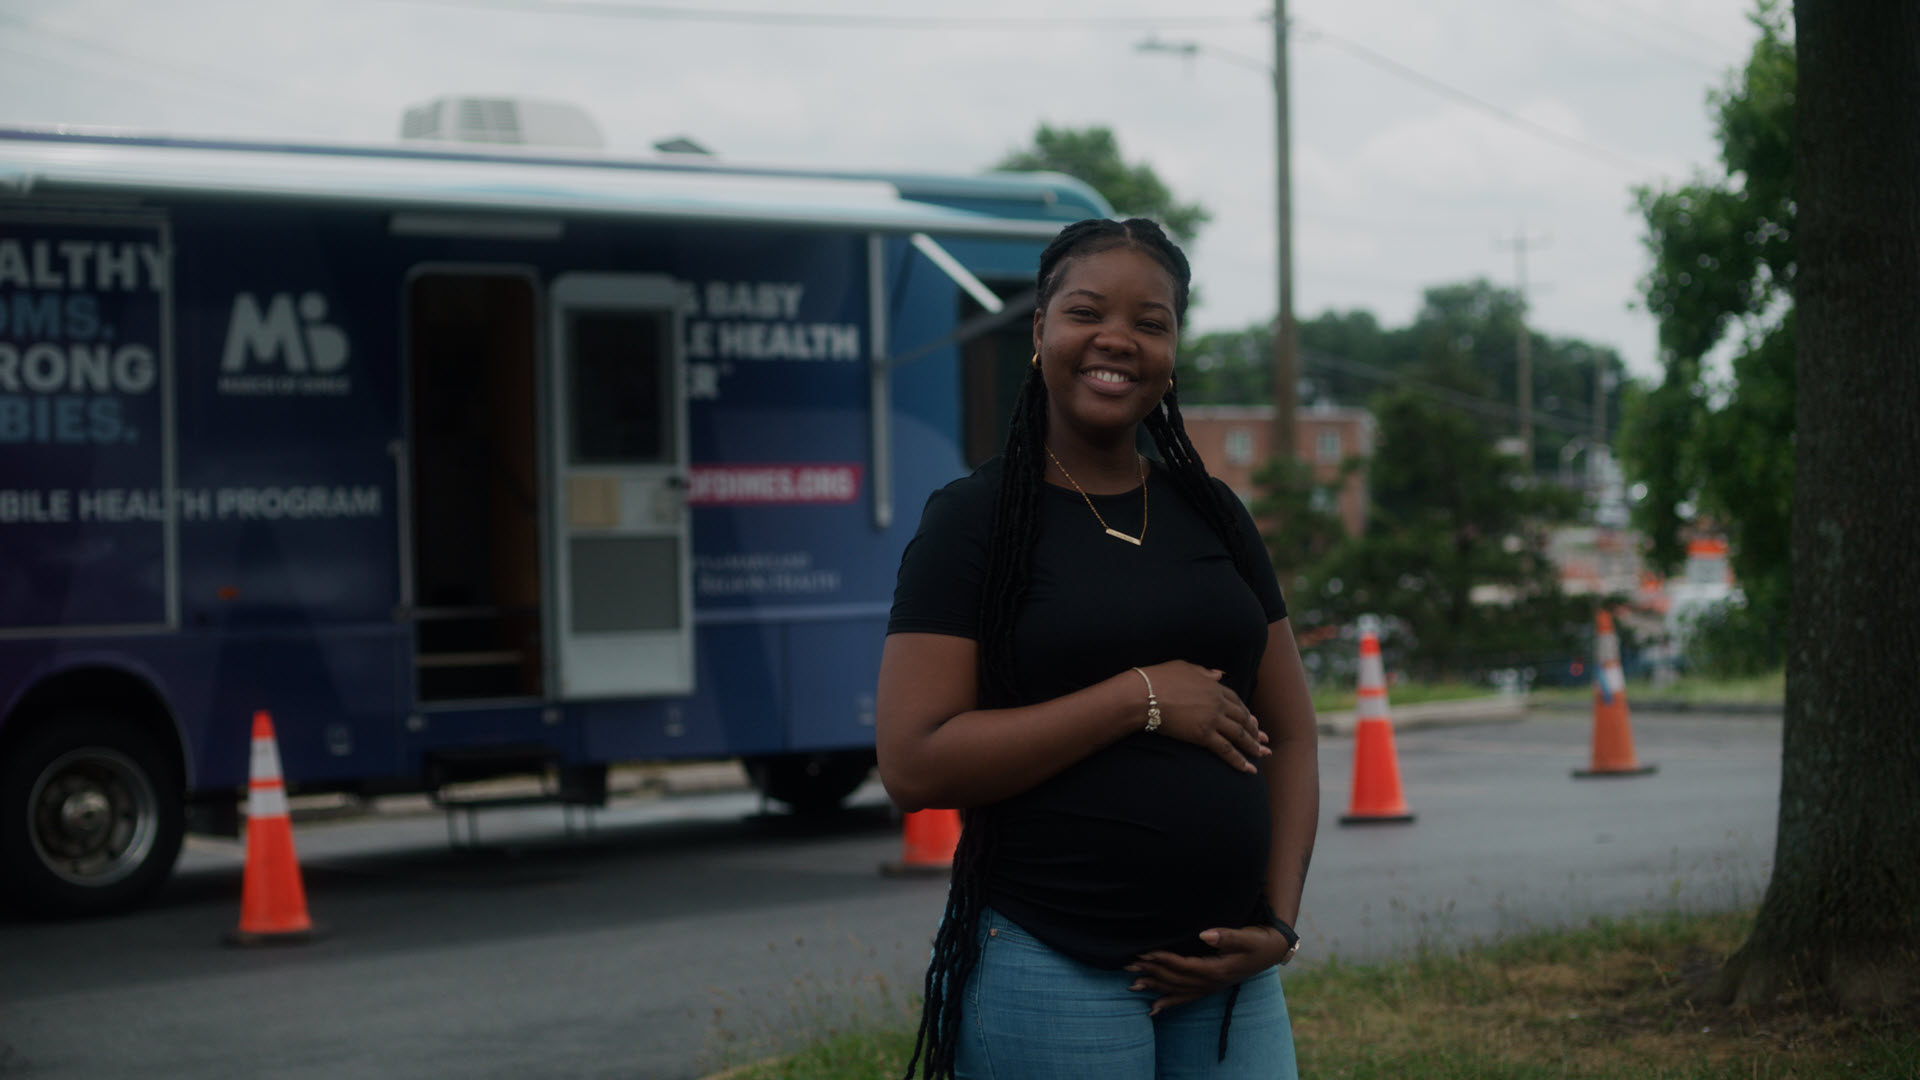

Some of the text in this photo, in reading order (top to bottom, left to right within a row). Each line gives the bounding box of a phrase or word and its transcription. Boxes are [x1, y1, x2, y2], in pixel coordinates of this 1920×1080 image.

[705, 282, 804, 318] BABY
[718, 321, 859, 361] HEALTH
[216, 486, 382, 520] PROGRAM
